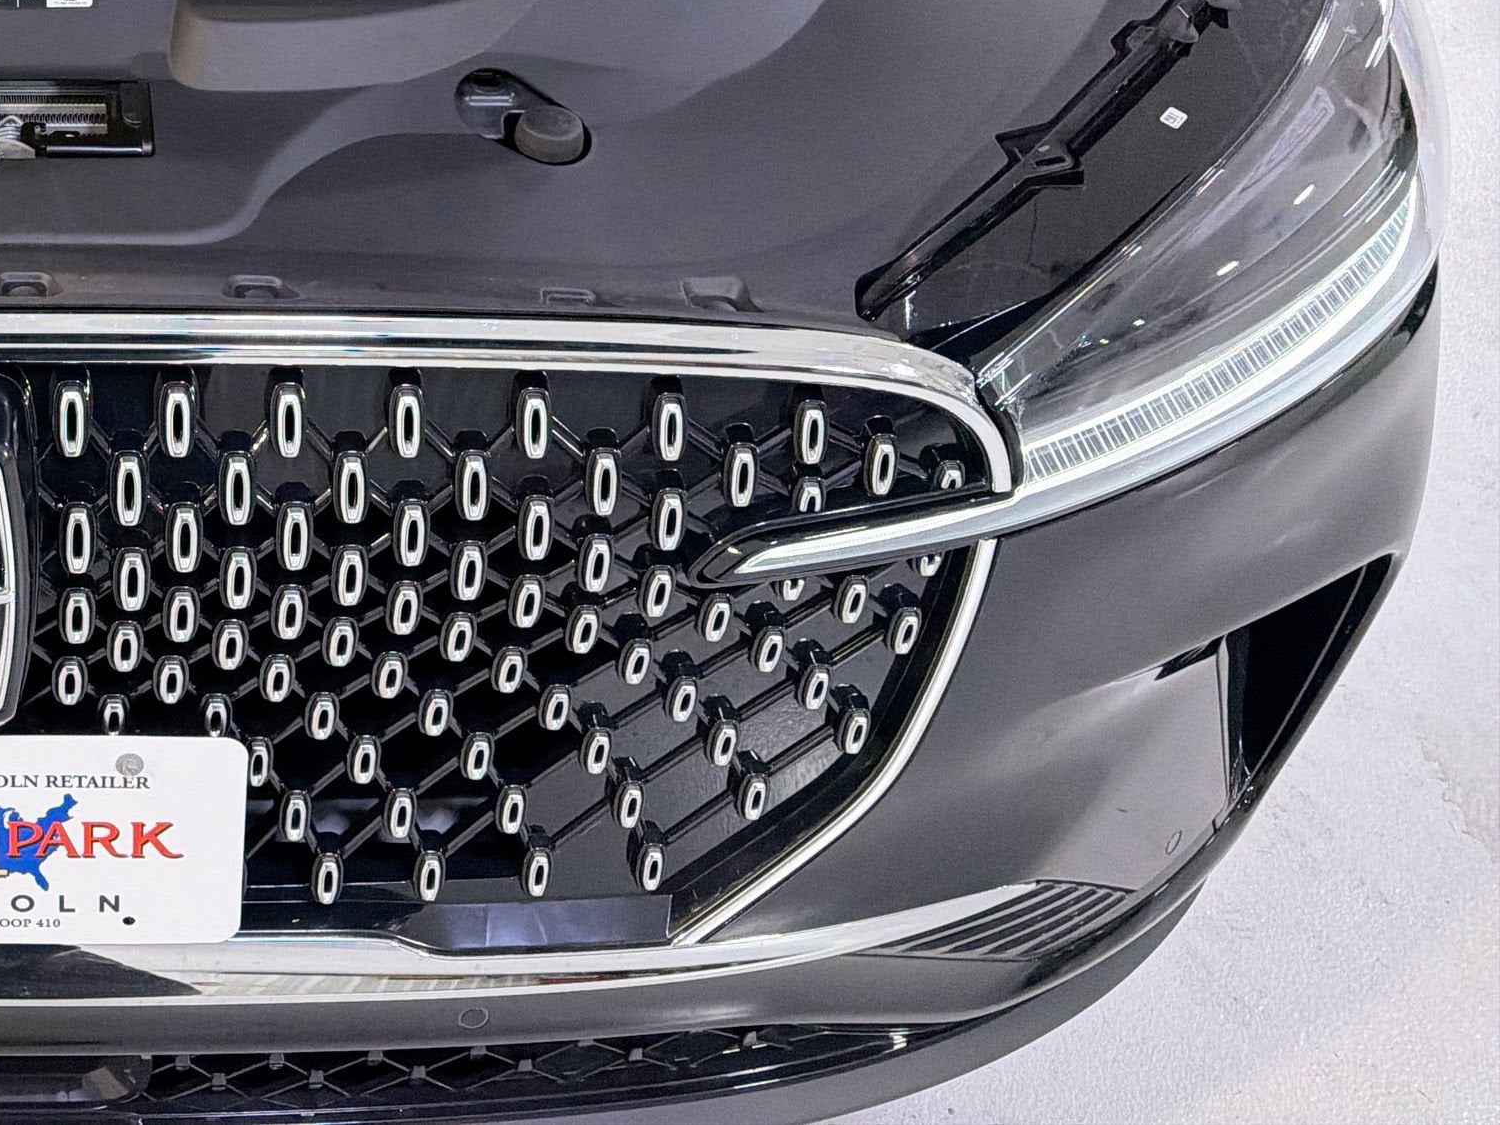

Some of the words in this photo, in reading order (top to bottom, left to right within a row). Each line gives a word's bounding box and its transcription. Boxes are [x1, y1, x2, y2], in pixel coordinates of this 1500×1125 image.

[45, 775, 150, 790] RETAILER
[6, 820, 184, 860] PARK
[36, 918, 60, 928] 410
